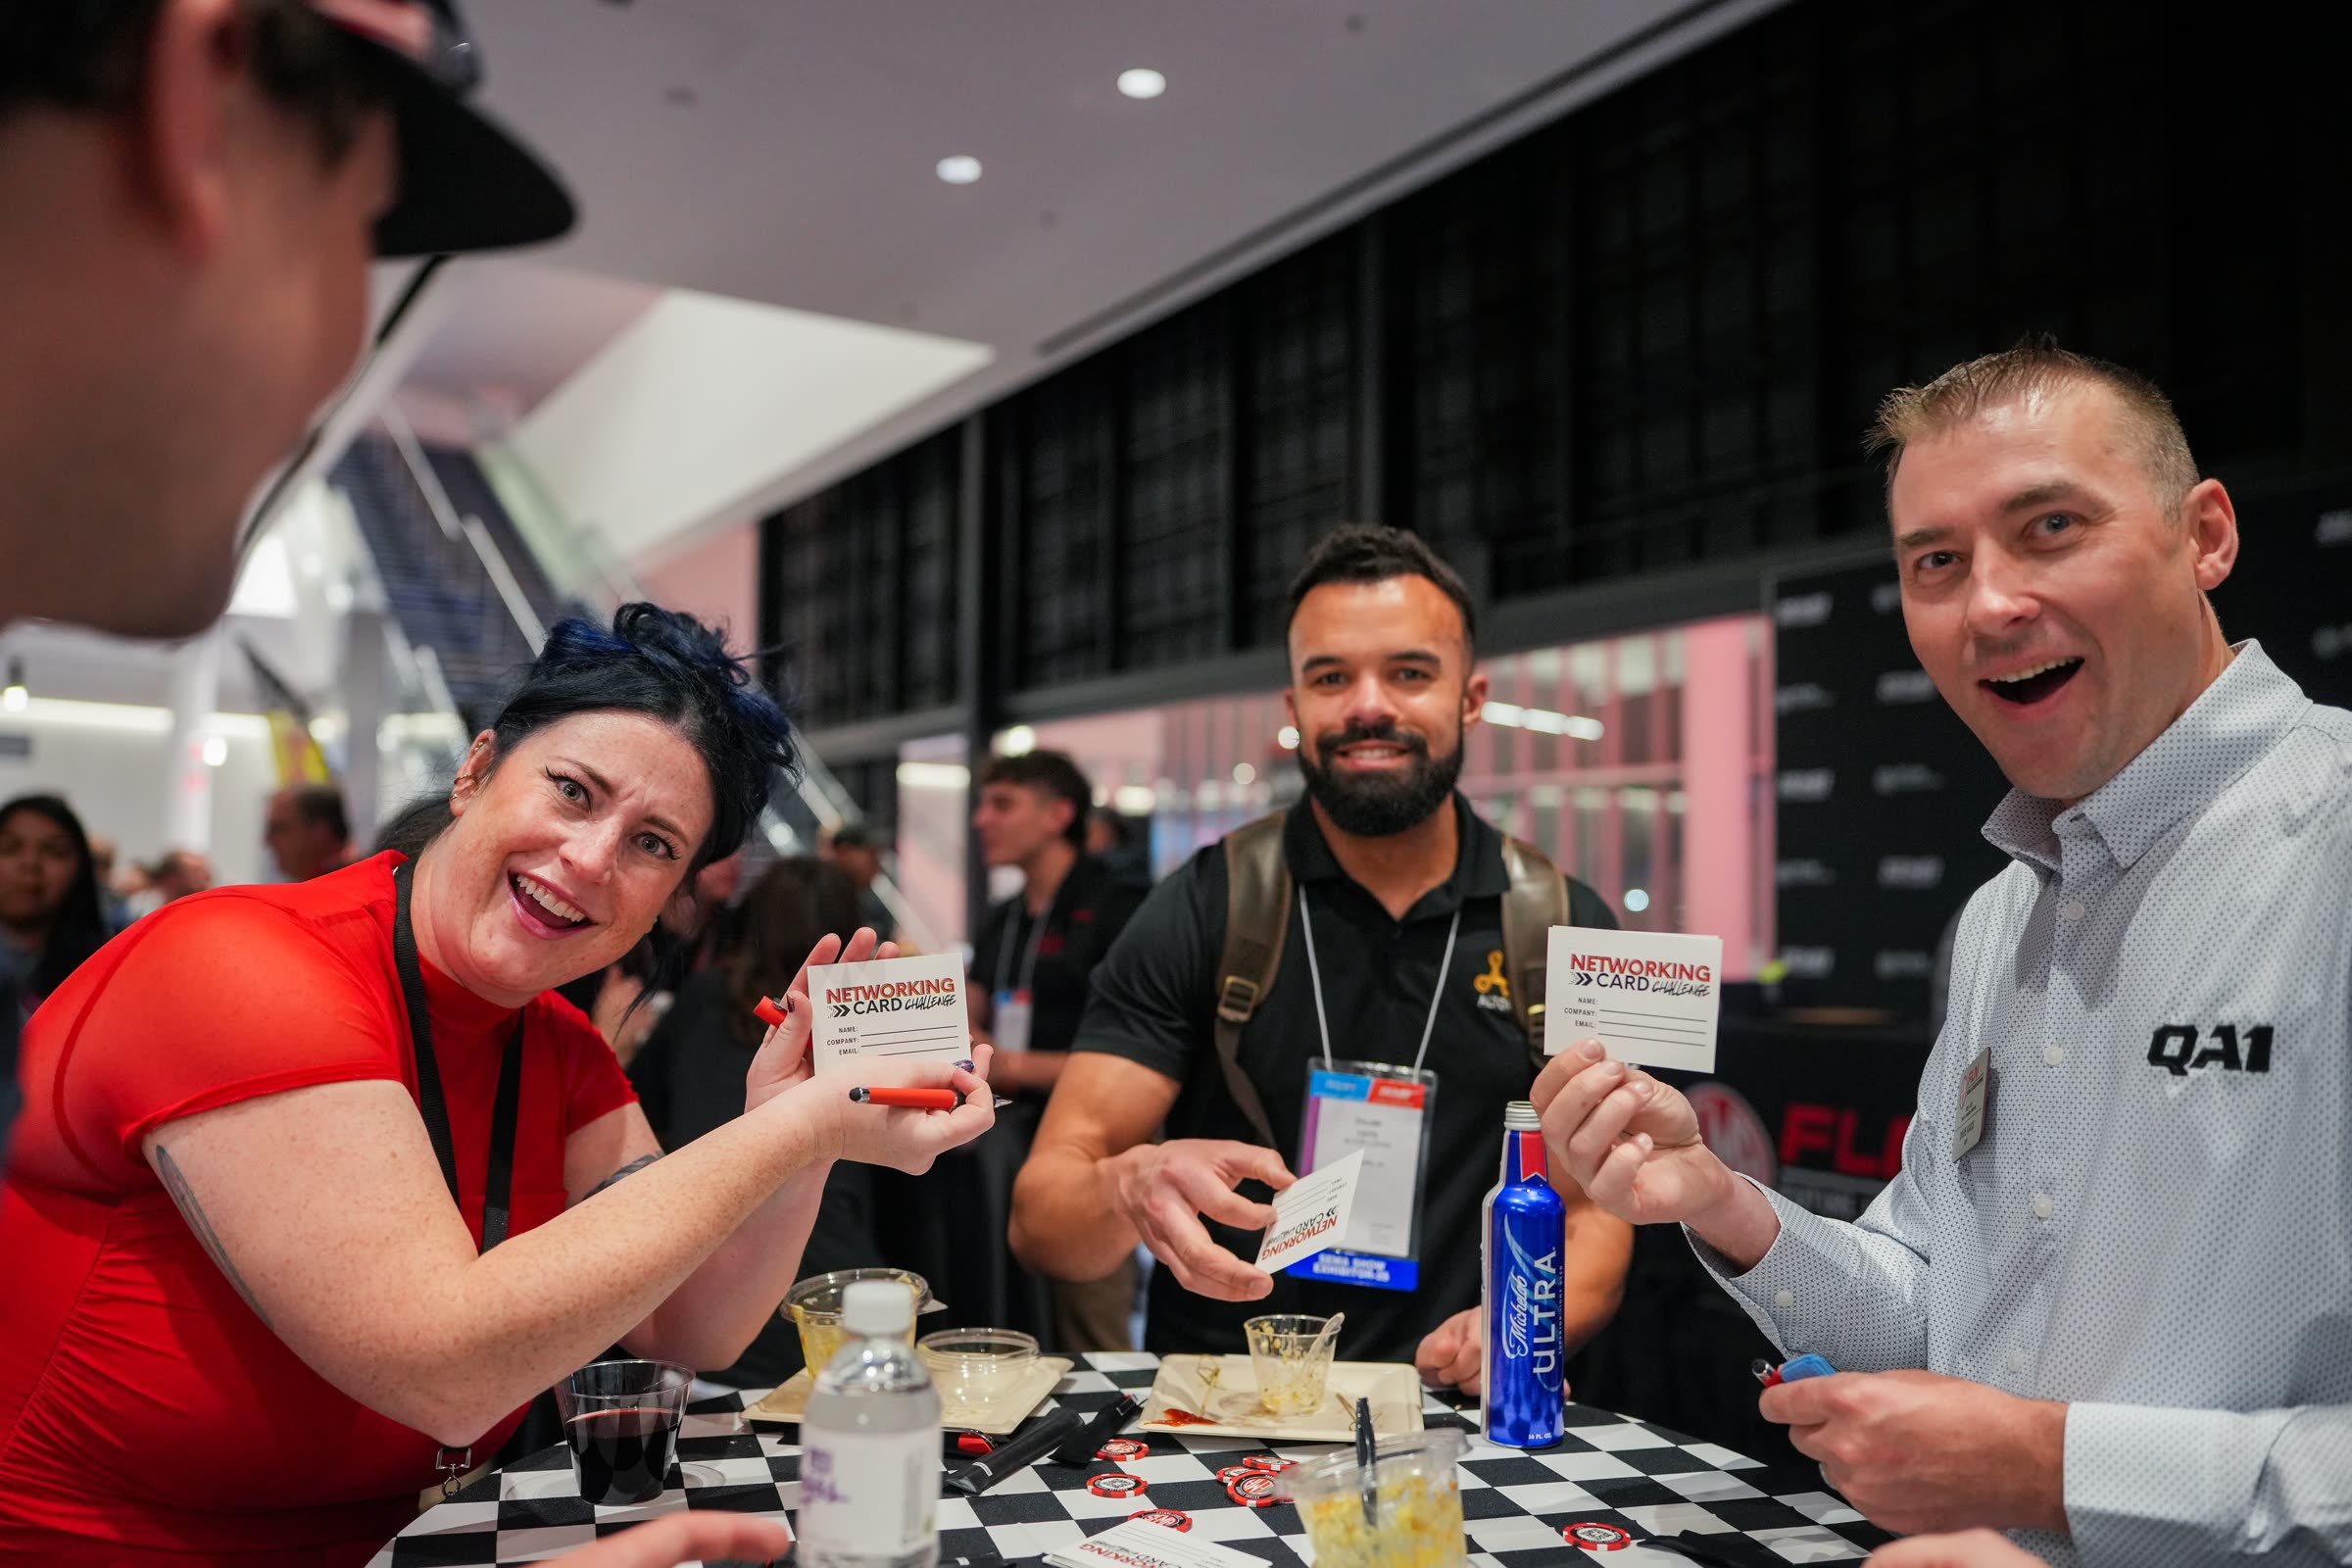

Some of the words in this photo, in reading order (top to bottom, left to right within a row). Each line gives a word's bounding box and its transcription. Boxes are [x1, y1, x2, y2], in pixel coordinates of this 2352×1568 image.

[1569, 953, 1711, 983] NETWORKING
[825, 977, 956, 1004] NETWORKING
[1596, 972, 1649, 992] CARD
[1651, 980, 1711, 998] CHALLENGE
[853, 996, 903, 1015] CARD
[905, 994, 956, 1011] CHALLENGE
[1563, 1006, 1598, 1017] COMPANY:
[1578, 997, 1598, 1005] NAME:
[1575, 1019, 1597, 1029] EMAIL:
[826, 1038, 859, 1047] COMPANY:
[2147, 1024, 2275, 1076] QA1
[1295, 1212, 1324, 1235] CARD
[1261, 1214, 1338, 1261] NETWORKING
[1508, 1271, 1529, 1356] Michelob
[1533, 1250, 1556, 1373] ULTRA
